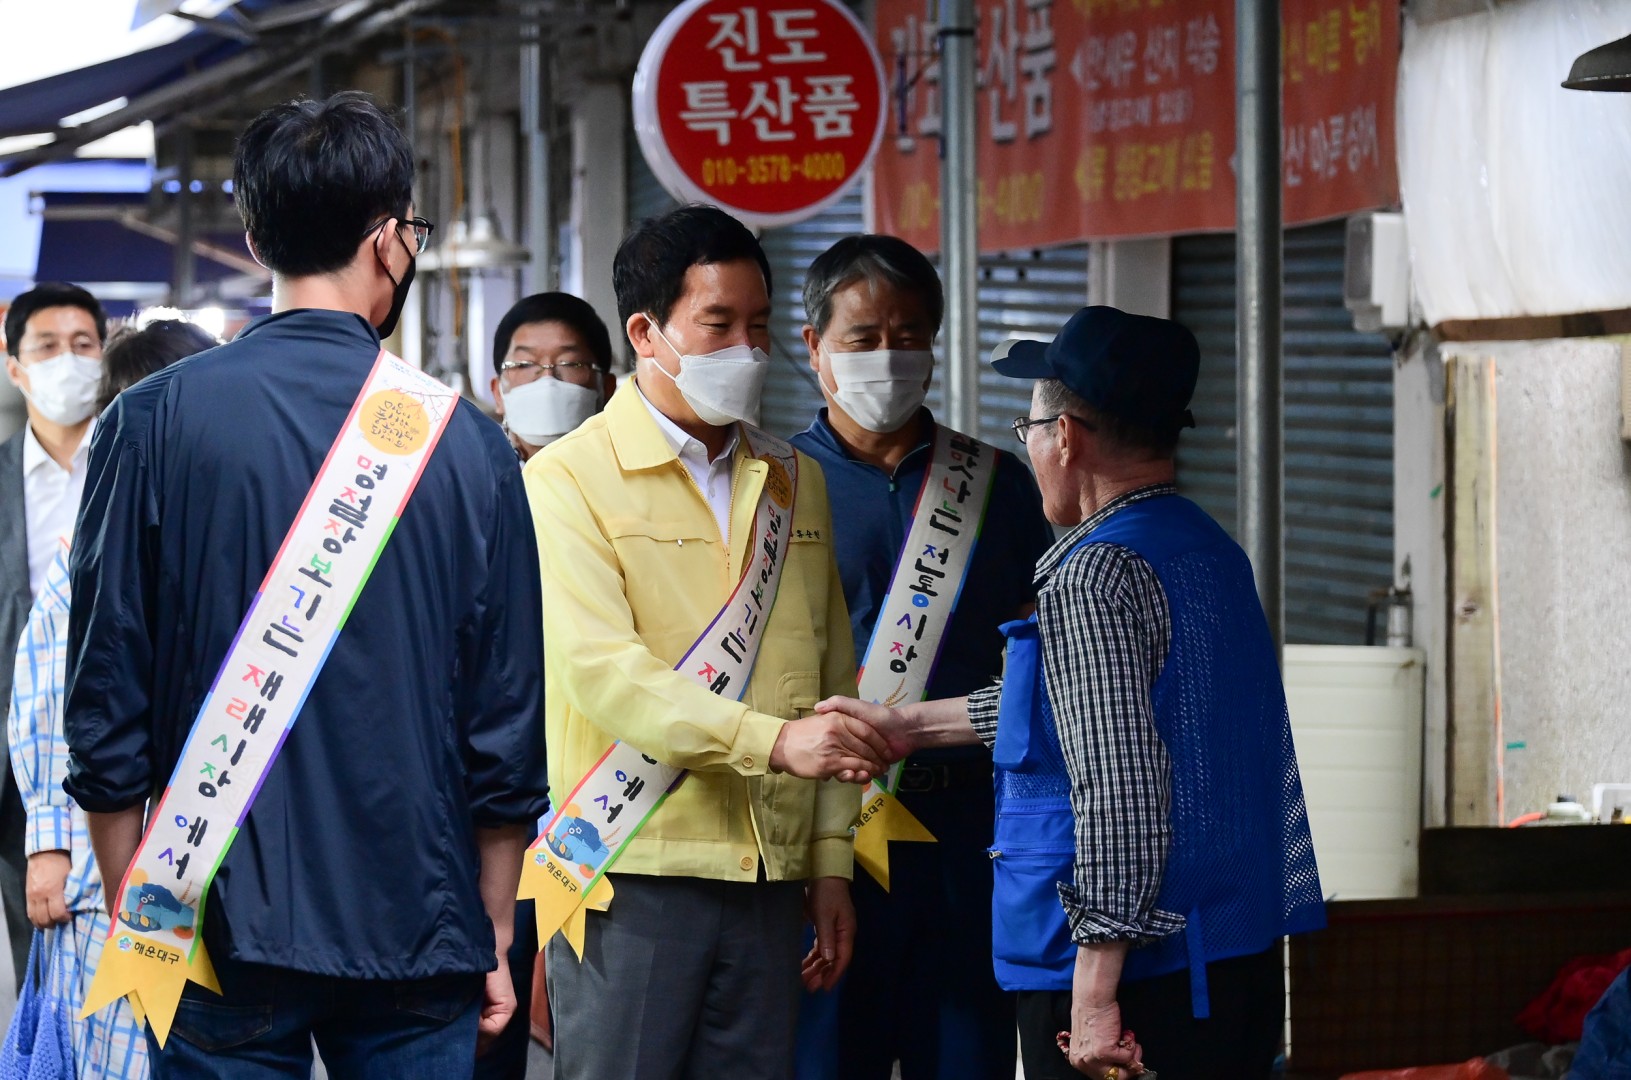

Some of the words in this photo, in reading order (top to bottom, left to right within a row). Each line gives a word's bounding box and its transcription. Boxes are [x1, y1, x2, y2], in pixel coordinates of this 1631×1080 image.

[706, 8, 827, 73] 진도
[679, 75, 860, 147] 특산품
[889, 544, 949, 674] 전통시장
[545, 862, 579, 895] 해운대구
[132, 940, 181, 966] 해운대구
